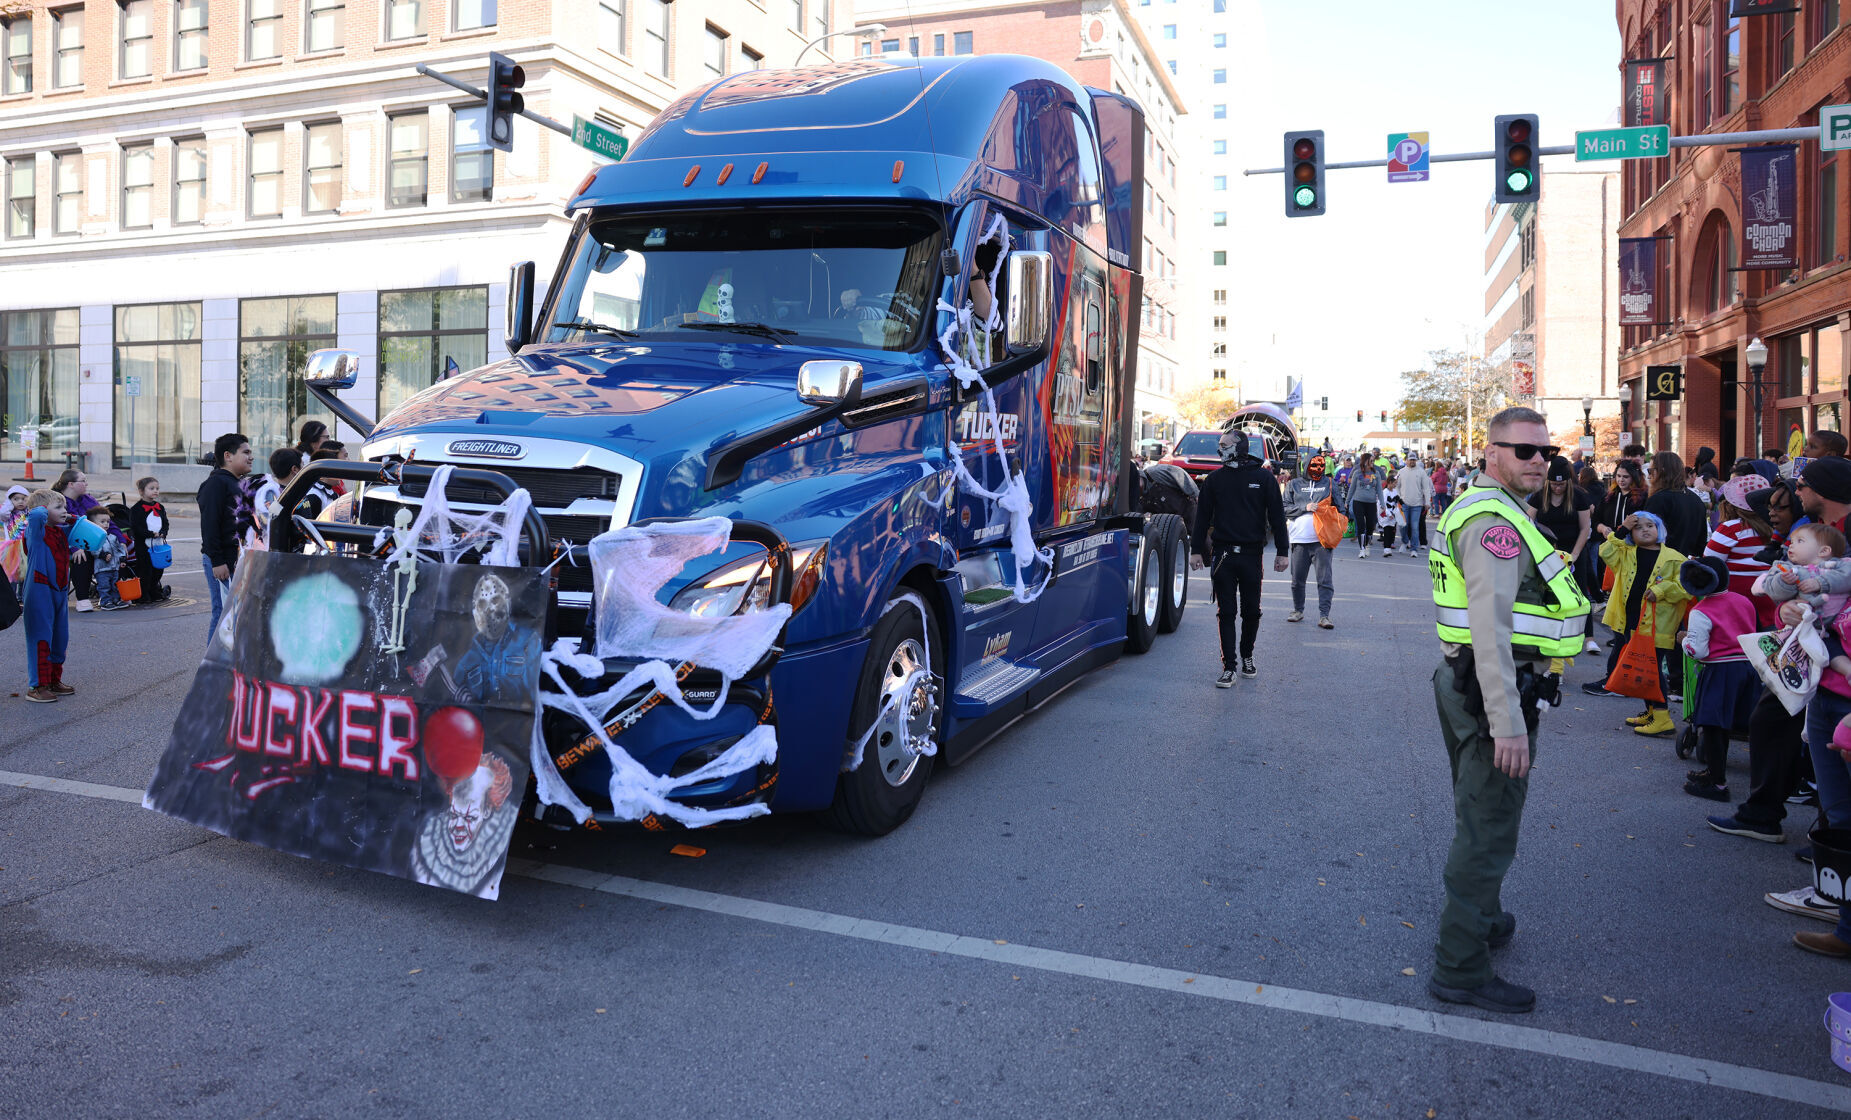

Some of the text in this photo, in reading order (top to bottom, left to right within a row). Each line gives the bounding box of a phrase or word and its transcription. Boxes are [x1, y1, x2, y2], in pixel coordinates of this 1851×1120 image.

[576, 123, 622, 157] 2nd Street
[1585, 134, 1659, 154] Main St
[451, 442, 519, 455] FREIGHTLINER
[556, 721, 624, 770] BEWAE!
